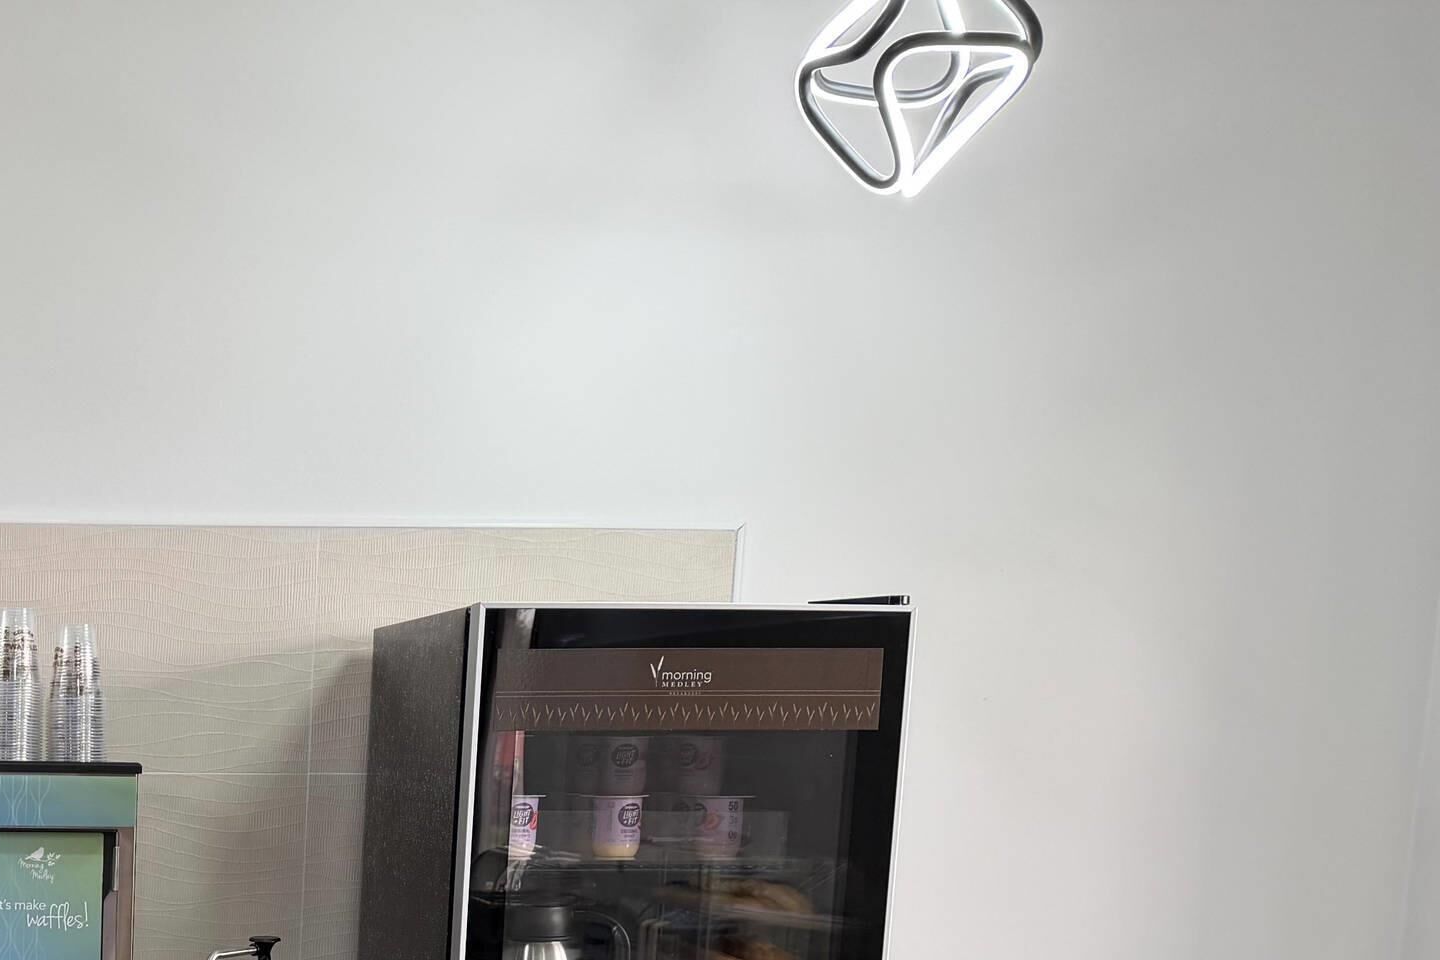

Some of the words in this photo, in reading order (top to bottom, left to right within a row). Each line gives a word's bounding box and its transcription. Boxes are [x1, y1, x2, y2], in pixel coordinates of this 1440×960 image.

[661, 668, 712, 684] morning
[513, 808, 532, 819] LIGHT
[622, 810, 639, 820] LIGHT
[14, 898, 47, 911] make
[26, 900, 89, 932] waffles!
